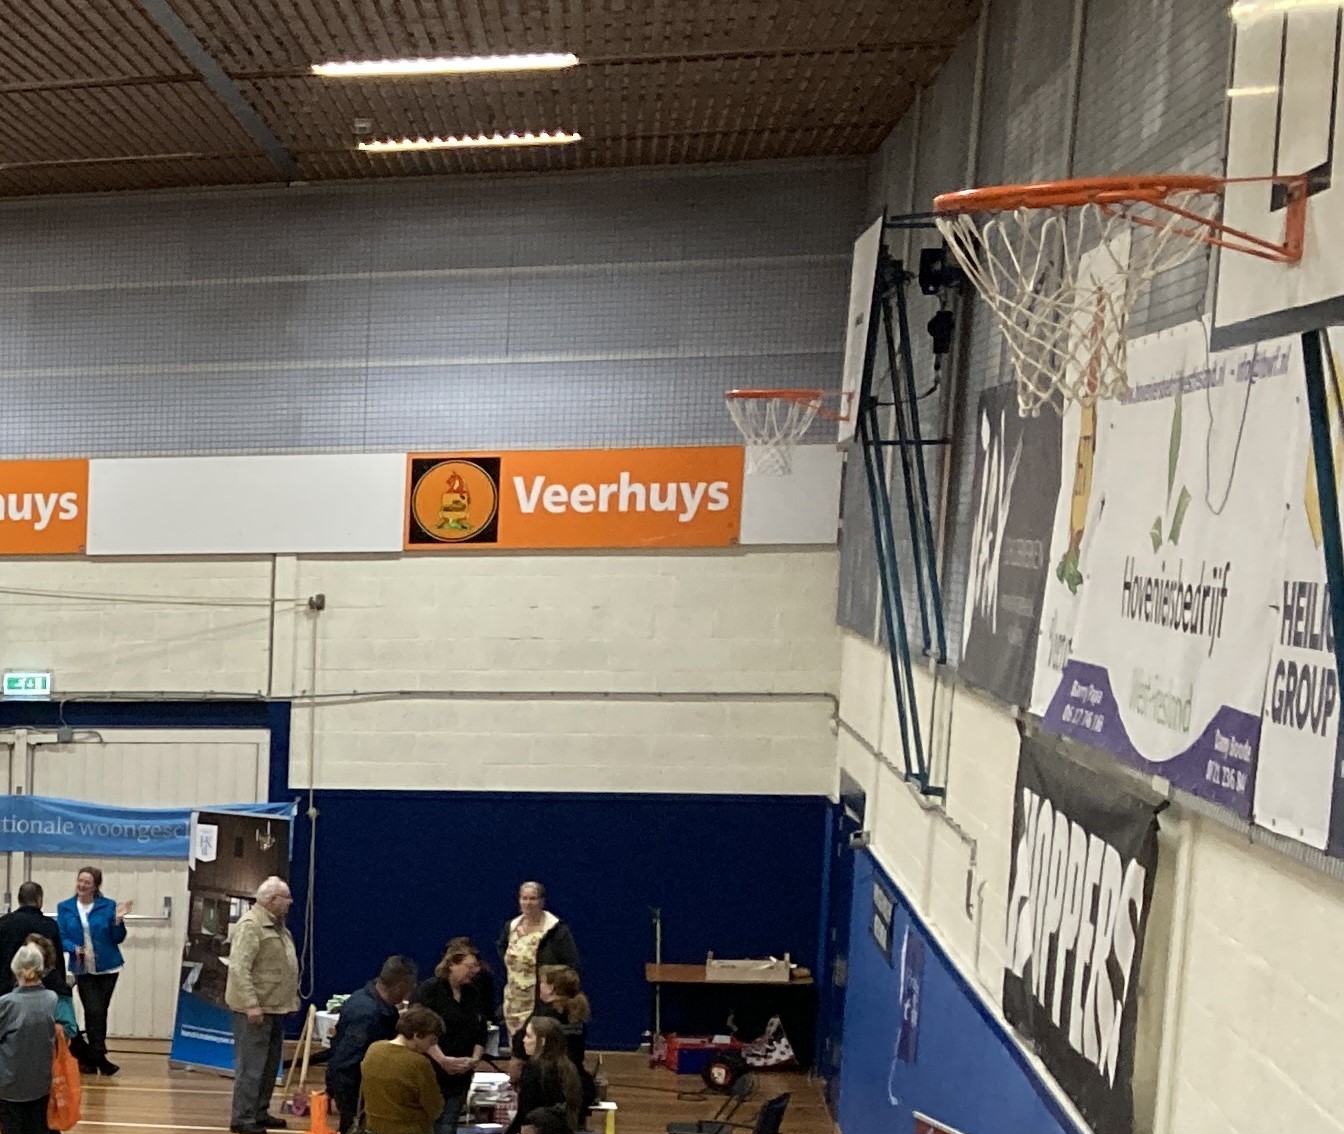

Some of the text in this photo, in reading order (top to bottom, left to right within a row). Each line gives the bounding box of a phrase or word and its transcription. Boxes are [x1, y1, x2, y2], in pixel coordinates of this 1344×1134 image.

[512, 472, 729, 522] Veerhuys
[1122, 556, 1230, 658] Hoveniersbedrijf
[1272, 660, 1336, 737] GROUP
[1013, 787, 1146, 1089] HOPPERS
